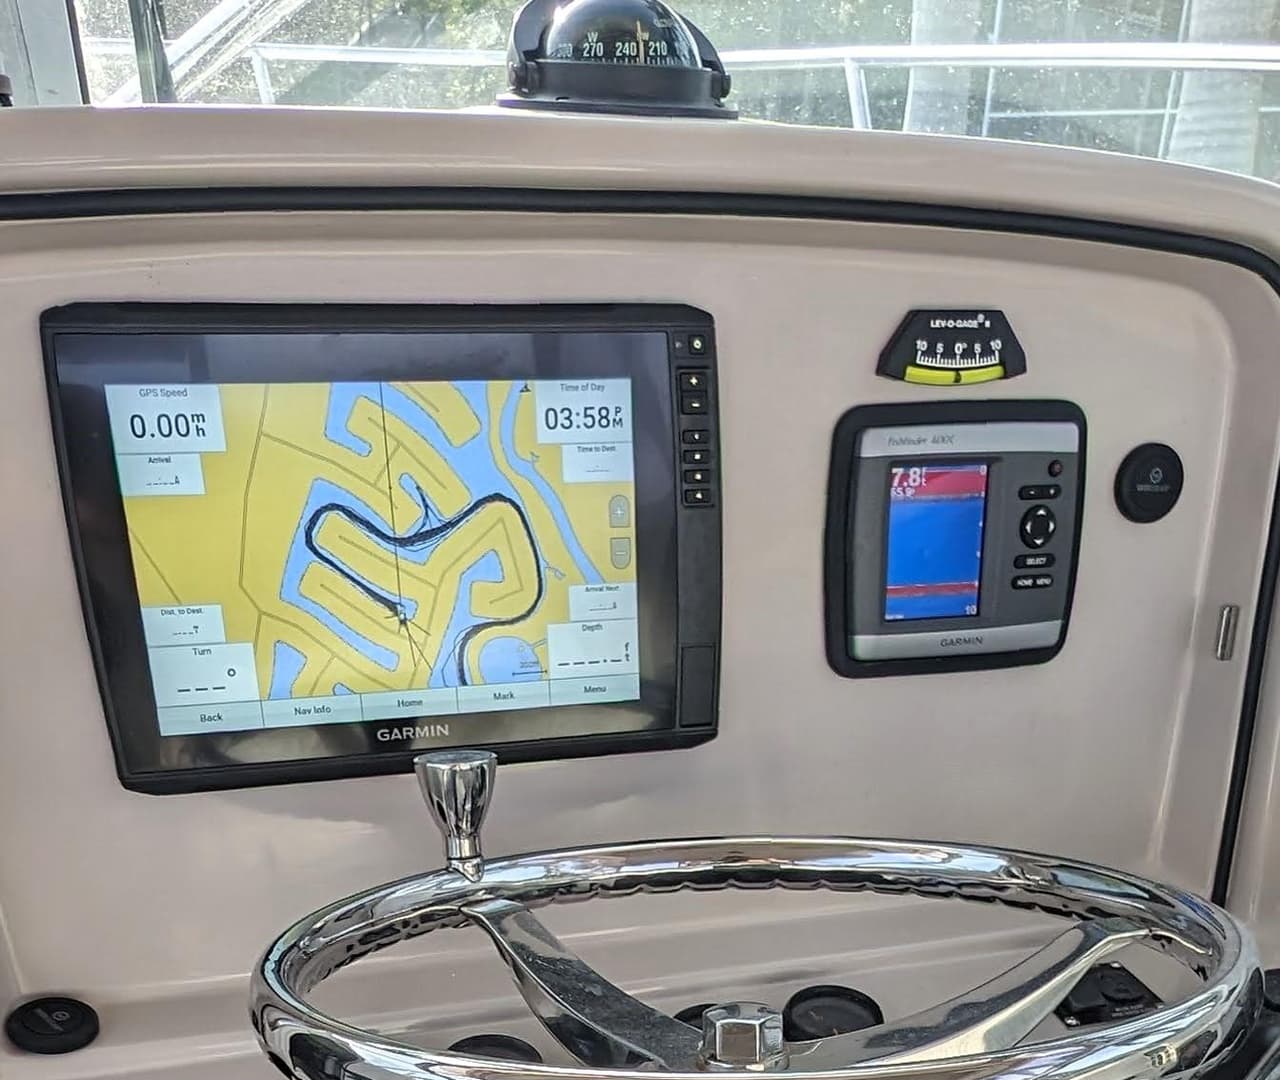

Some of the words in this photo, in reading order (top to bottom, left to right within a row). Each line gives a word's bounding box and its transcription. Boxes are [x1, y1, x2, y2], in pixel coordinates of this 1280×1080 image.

[587, 32, 598, 42] W
[583, 43, 604, 57] 270
[615, 42, 638, 56] 240
[648, 42, 668, 56] 210
[916, 340, 928, 351] 10
[936, 343, 945, 353] 5
[974, 343, 982, 353] 5
[989, 339, 1002, 350] 10
[560, 383, 579, 392] Time
[580, 383, 589, 391] of
[591, 382, 605, 392] Day
[138, 388, 158, 398] GPS
[160, 388, 188, 398] Speed
[614, 406, 622, 417] P
[190, 413, 206, 423] m
[544, 406, 610, 430] 03:58
[612, 418, 623, 428] M
[129, 413, 190, 439] 0.00
[196, 424, 206, 437] h
[891, 467, 921, 487] 7.8
[965, 605, 978, 616] 10
[581, 623, 604, 632] Depth
[940, 637, 983, 648] GARMIN
[192, 647, 212, 656] Turn
[583, 685, 608, 694] Menu
[493, 691, 515, 701] Mark
[397, 698, 423, 708] Home
[294, 706, 312, 716] Nav
[313, 705, 332, 715] Info
[199, 713, 224, 723] Back
[376, 723, 450, 742] GARMIN
